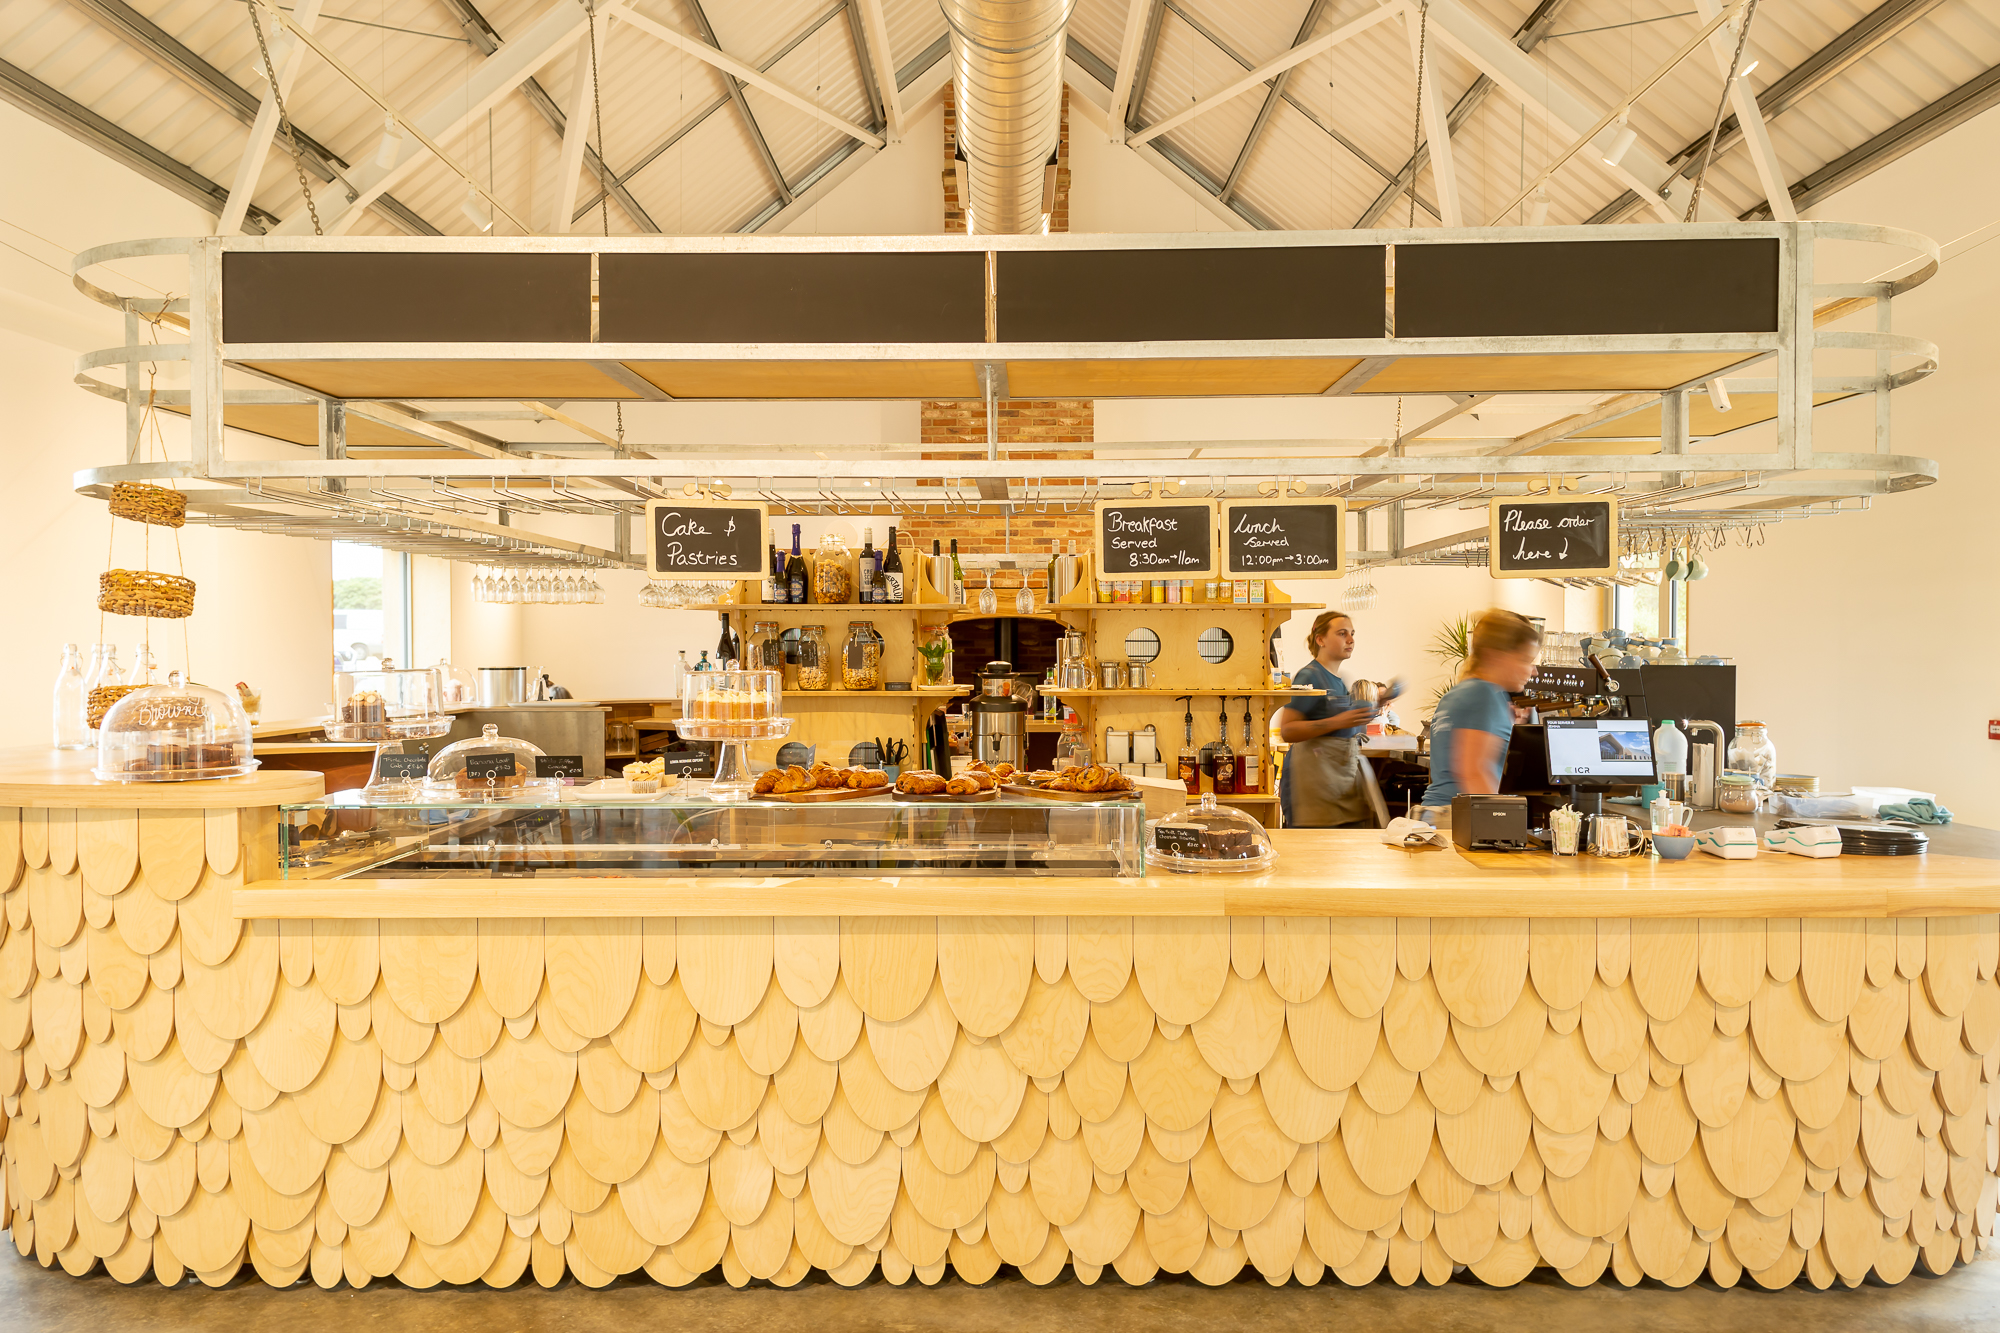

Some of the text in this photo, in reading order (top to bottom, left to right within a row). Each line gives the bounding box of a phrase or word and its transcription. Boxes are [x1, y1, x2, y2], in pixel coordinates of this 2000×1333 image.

[661, 512, 712, 537] Cake
[1107, 511, 1178, 536] Breakfast
[1233, 513, 1285, 534] Lunch
[1503, 509, 1595, 532] Please order
[1111, 536, 1158, 549] Served
[1243, 536, 1289, 548] Served
[1512, 536, 1552, 560] here
[667, 541, 738, 566] Pastries
[469, 758, 495, 766] Banana
[1574, 766, 1591, 774] ICR
